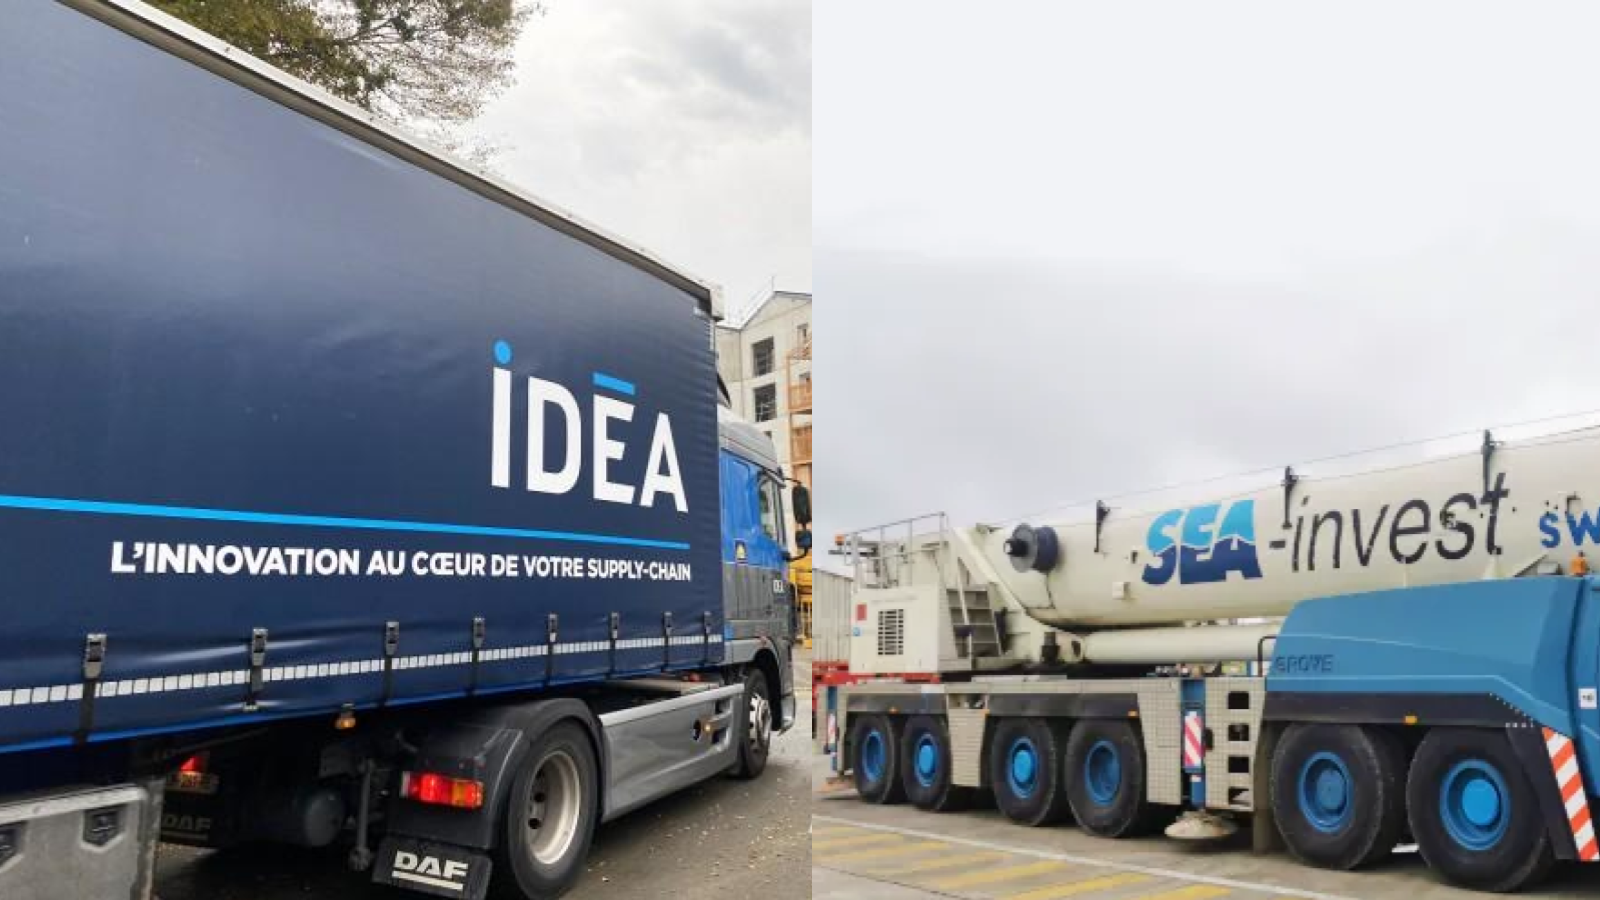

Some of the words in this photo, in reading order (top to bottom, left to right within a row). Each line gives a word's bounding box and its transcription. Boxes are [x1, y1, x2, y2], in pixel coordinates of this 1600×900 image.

[111, 541, 360, 576] L'INNOVATION
[366, 550, 406, 576] AU
[491, 554, 519, 577] DE
[523, 555, 584, 578] VOTRE
[587, 558, 691, 582] SUPPLY-CHAIN
[393, 850, 469, 880] DAF
